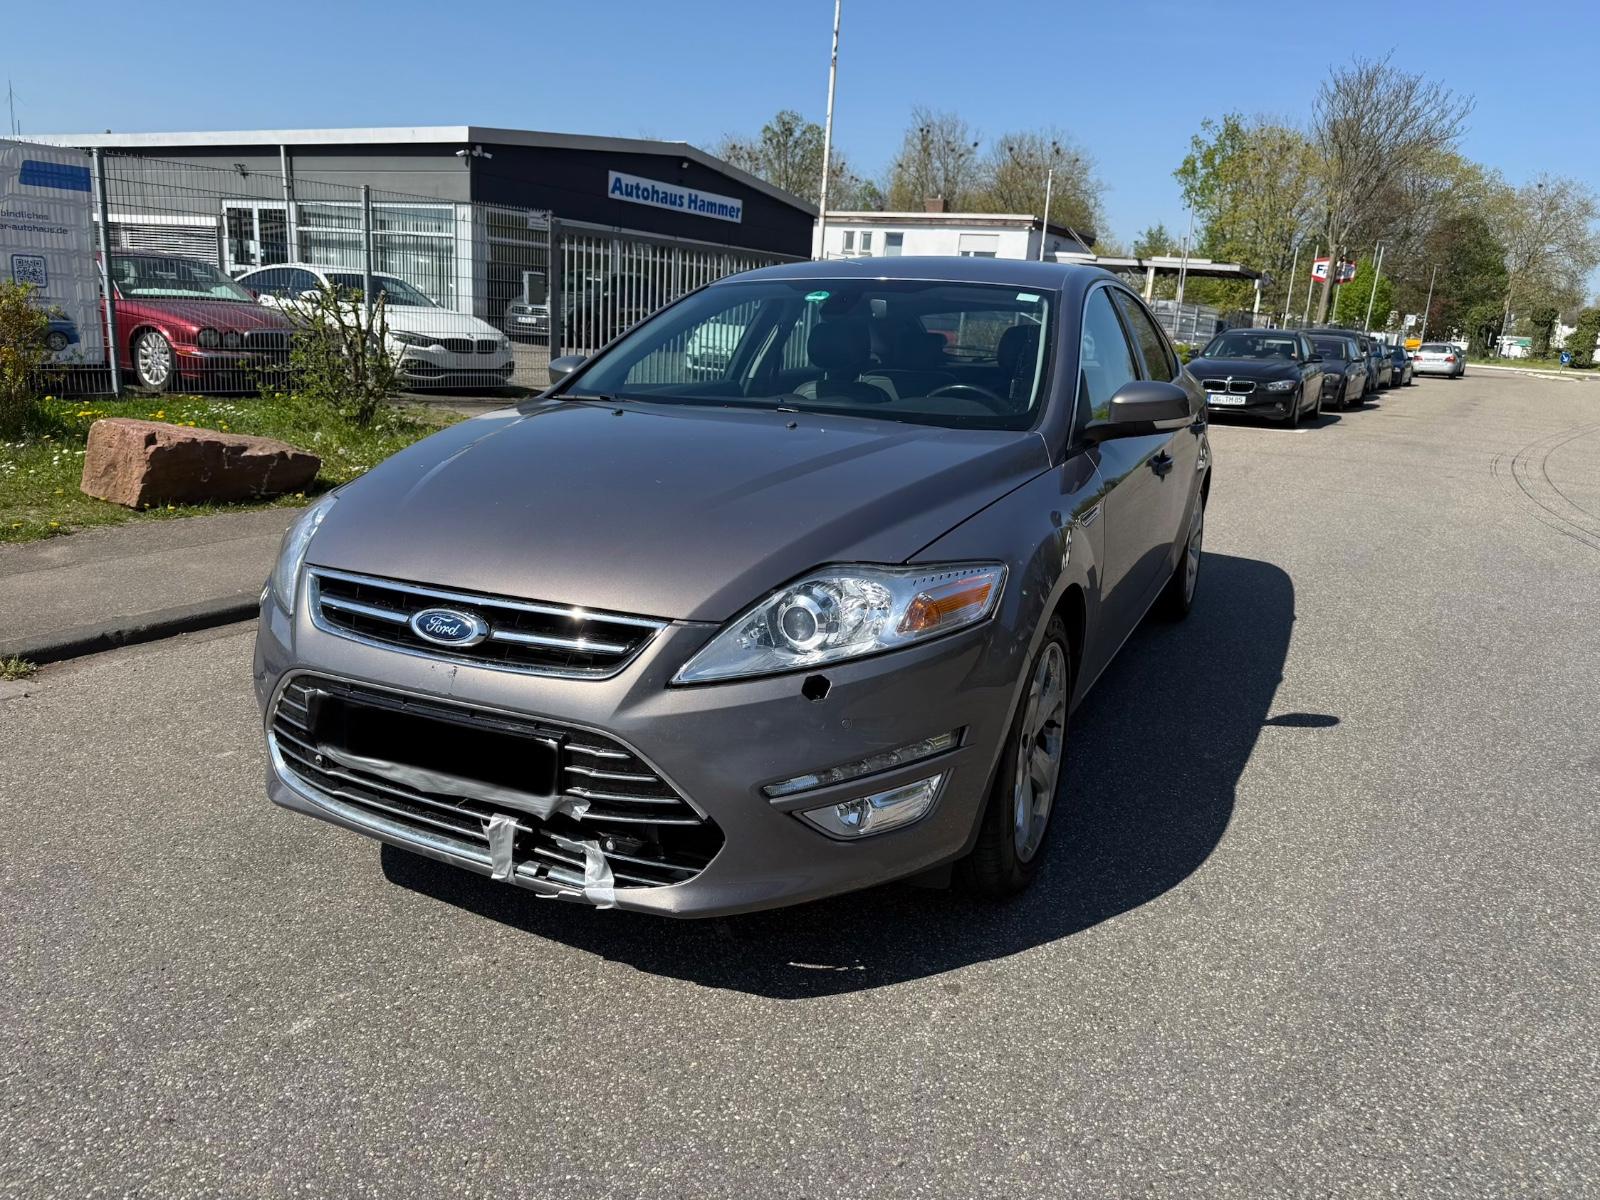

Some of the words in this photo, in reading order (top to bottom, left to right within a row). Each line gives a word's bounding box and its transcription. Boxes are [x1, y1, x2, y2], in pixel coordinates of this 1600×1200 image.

[611, 177, 685, 208] Autohaus
[687, 193, 741, 219] Hammer
[425, 615, 461, 636] Ford
